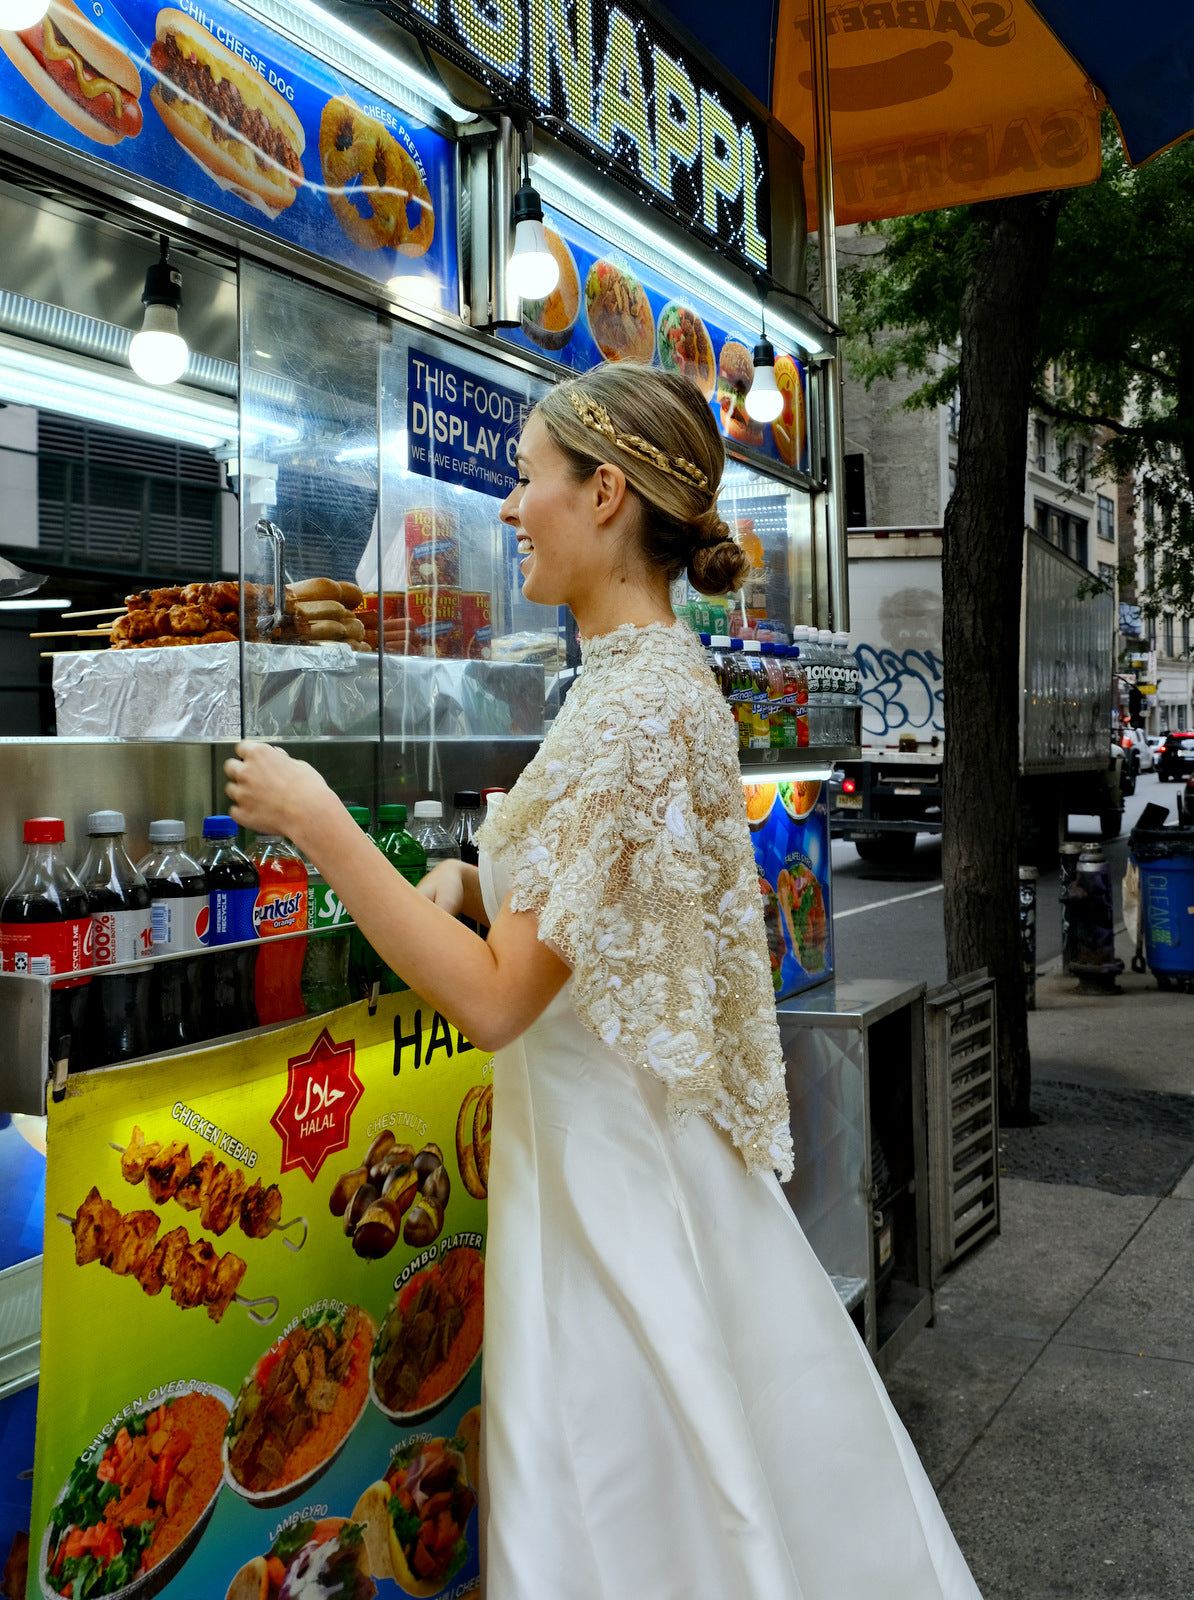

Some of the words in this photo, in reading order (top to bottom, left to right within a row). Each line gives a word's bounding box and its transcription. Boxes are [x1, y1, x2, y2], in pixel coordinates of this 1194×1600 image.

[179, 0, 214, 34] CHILI
[216, 26, 266, 78] CHEESE
[268, 70, 295, 101] DOG
[363, 104, 398, 130] CHEESE
[398, 125, 428, 187] PRETZEL
[412, 359, 457, 403] THIS
[463, 381, 514, 424] FOOD
[412, 401, 501, 461] DISPLAY
[411, 445, 426, 462] WE
[427, 450, 450, 469] HAVE
[452, 459, 502, 486] EVERYTHING
[273, 917, 296, 928] Orange
[318, 889, 349, 924] Sp
[72, 924, 79, 939] ME
[94, 915, 111, 967] 100%
[294, 1074, 346, 1121] حلال
[171, 1101, 222, 1146] CHICKEN
[218, 1132, 258, 1169] KEBAB
[300, 1113, 335, 1138] HALAL
[366, 1111, 428, 1138] CHESTNUTS
[393, 1244, 438, 1291] COMBO
[440, 1232, 483, 1253] PLATTER
[270, 1316, 299, 1354] LAMB
[301, 1298, 328, 1320] OVER
[329, 1298, 349, 1317] RICE
[80, 1396, 143, 1463] CHICKEN
[147, 1379, 186, 1401] OVER
[188, 1378, 213, 1397] RICE
[389, 1440, 407, 1457] MIX
[408, 1432, 433, 1445] GYRO
[269, 1512, 301, 1542] LAMB
[301, 1503, 329, 1519] GYRO
